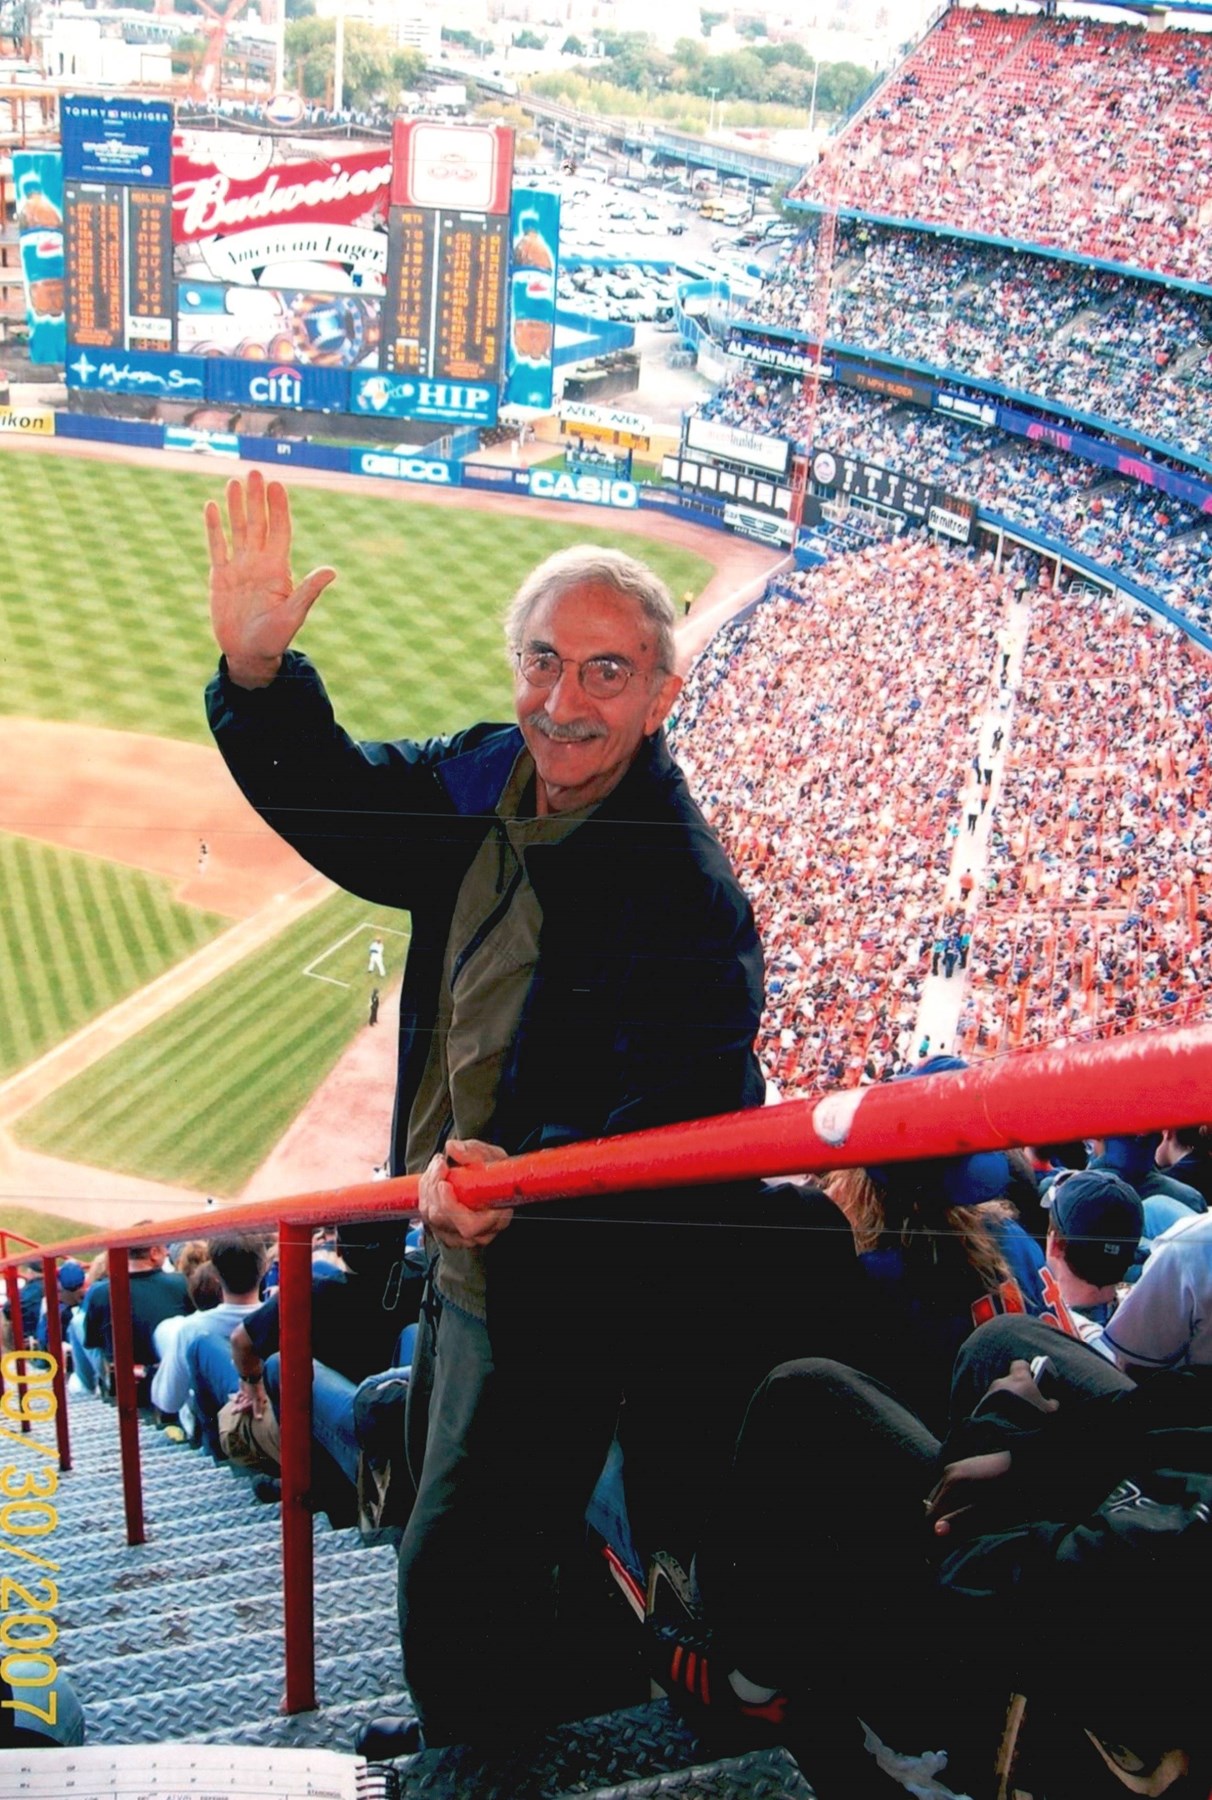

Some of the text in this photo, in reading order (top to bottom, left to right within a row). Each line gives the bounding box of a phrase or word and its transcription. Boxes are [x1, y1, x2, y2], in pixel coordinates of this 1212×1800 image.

[65, 106, 106, 117] TOMMY
[121, 110, 169, 122] HILFIGER
[172, 162, 392, 234] Budweiser
[249, 372, 301, 403] citi
[418, 382, 490, 410] HIP
[0, 411, 44, 429] ikon
[360, 453, 451, 482] GEICO
[530, 469, 637, 507] CASIO
[929, 509, 969, 537] Armitron
